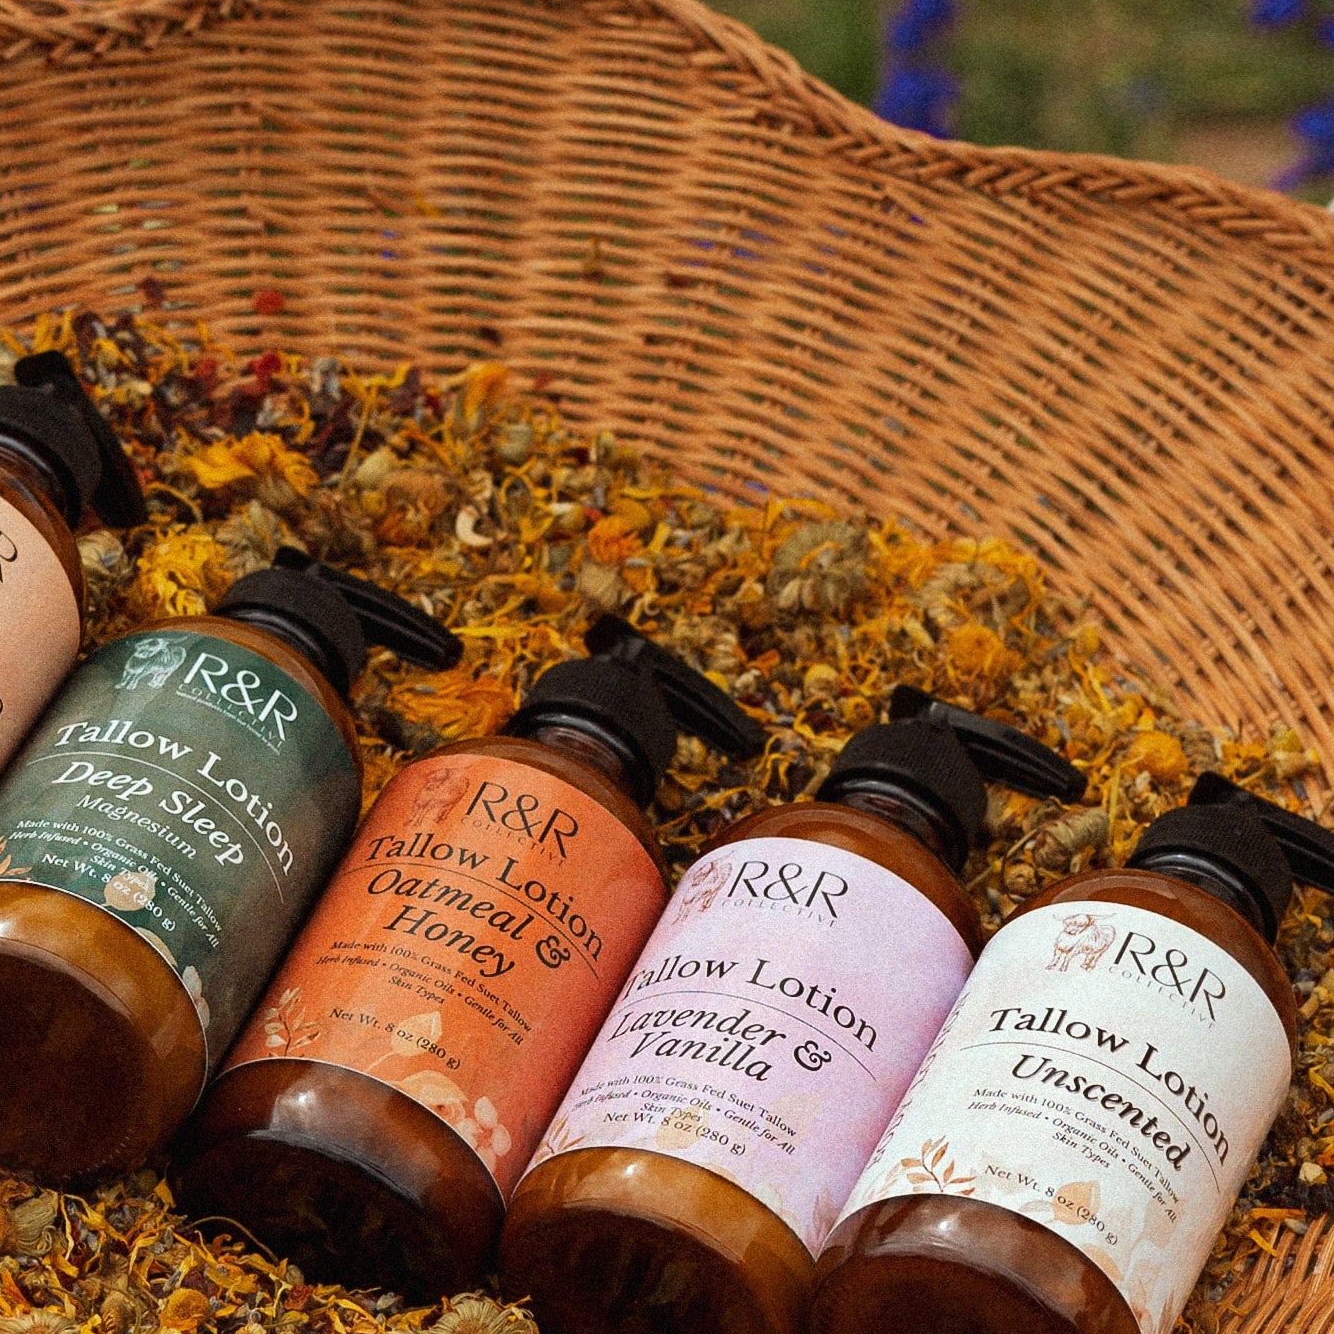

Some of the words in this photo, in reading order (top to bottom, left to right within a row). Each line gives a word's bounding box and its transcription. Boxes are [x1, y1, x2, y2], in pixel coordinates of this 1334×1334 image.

[184, 652, 297, 741] R&R
[52, 761, 154, 801] Deep
[158, 790, 244, 866] Sleep
[55, 720, 193, 760] Tallow
[196, 751, 294, 876] Lotion
[76, 795, 198, 860] Magnesium
[466, 781, 578, 858] R&R
[8, 831, 37, 840] Herb
[38, 832, 82, 845] Infused
[91, 843, 136, 867] Organic
[167, 887, 196, 916] Gentle
[192, 916, 208, 930] for
[206, 932, 219, 948] All
[17, 820, 50, 828] Made
[53, 822, 79, 832] with
[82, 826, 112, 842] 100%
[116, 838, 148, 859] Grass
[150, 856, 172, 875] Fed
[172, 872, 195, 897] Suet
[195, 894, 222, 932] Tallow
[42, 853, 69, 867] Net
[74, 861, 97, 878] Wt.
[101, 873, 112, 883] 8
[112, 881, 131, 895] oz
[133, 892, 163, 917] (280
[162, 918, 176, 931] g)
[90, 855, 117, 871] Skin
[365, 832, 491, 870] Tallow
[496, 857, 603, 962] Lotion
[727, 860, 848, 919] R&R
[367, 868, 534, 940] Oatmeal
[536, 935, 571, 969] &
[383, 905, 515, 977] Honey
[331, 941, 360, 950] Made
[363, 942, 387, 952] with
[390, 947, 419, 960] 100%
[421, 956, 452, 974] Grass
[454, 970, 476, 987] Fed
[476, 984, 500, 1005] Suet
[502, 1000, 532, 1032] Tallow
[342, 955, 380, 966] Infused
[389, 963, 432, 983] Organic
[434, 980, 455, 994] Oils
[465, 996, 495, 1020] Gentle
[492, 1018, 510, 1032] for
[508, 1031, 523, 1046] All
[388, 976, 412, 989] Skin
[416, 985, 445, 1004] Types
[624, 954, 739, 1000] Tallow
[746, 958, 877, 1052] Lotion
[1114, 932, 1225, 1022] R&R
[329, 1008, 355, 1021] Net
[359, 1013, 381, 1029] Wt.
[385, 1022, 395, 1032] 8
[397, 1029, 414, 1042] oz
[416, 1036, 446, 1059] (280
[446, 1057, 461, 1070] g)
[608, 1008, 787, 1046] Lavender
[794, 1040, 832, 1071] &
[630, 1031, 774, 1081] Vanilla
[607, 1076, 630, 1087] with
[633, 1075, 663, 1085] 100%
[666, 1077, 698, 1090] Grass
[702, 1084, 726, 1099] Fed
[728, 1093, 755, 1112] Suet
[756, 1107, 797, 1137] Tallow
[640, 1102, 666, 1113] Skin
[670, 1107, 702, 1122] Types
[641, 1090, 687, 1105] Organic
[690, 1097, 712, 1111] Oils
[724, 1109, 760, 1133] Gentle
[758, 1129, 778, 1143] for
[777, 1142, 796, 1155] All
[989, 1007, 1129, 1053] Tallow
[1136, 1042, 1229, 1165] Lotion
[1011, 1054, 1191, 1171] Unscented
[603, 1112, 628, 1123] Net
[633, 1113, 656, 1125] Wt.
[661, 1117, 670, 1126] 8
[674, 1121, 692, 1133] oz
[695, 1125, 729, 1145] (280
[730, 1143, 746, 1156] g)
[967, 1101, 997, 1110] Herb
[999, 1103, 1042, 1119] Infused
[1052, 1118, 1098, 1144] Organic
[1099, 1142, 1119, 1159] Oils
[1128, 1163, 1155, 1193] Gentle
[1152, 1192, 1166, 1206] for
[1165, 1208, 1177, 1223] All
[973, 1088, 1008, 1097] Made
[1011, 1093, 1037, 1104] with
[1041, 1099, 1071, 1115] 100%
[1075, 1111, 1106, 1133] Grass
[1109, 1130, 1130, 1149] Fed
[1131, 1147, 1152, 1170] Suet
[1154, 1167, 1179, 1204] Tallow
[1052, 1131, 1078, 1148] Skin
[1080, 1145, 1110, 1168] Types
[985, 1165, 1012, 1180] Net
[1017, 1173, 1040, 1192] Wt.
[1045, 1187, 1055, 1197] 8
[1057, 1195, 1074, 1209] oz
[1077, 1206, 1105, 1231] (280
[1105, 1232, 1118, 1246] g)
